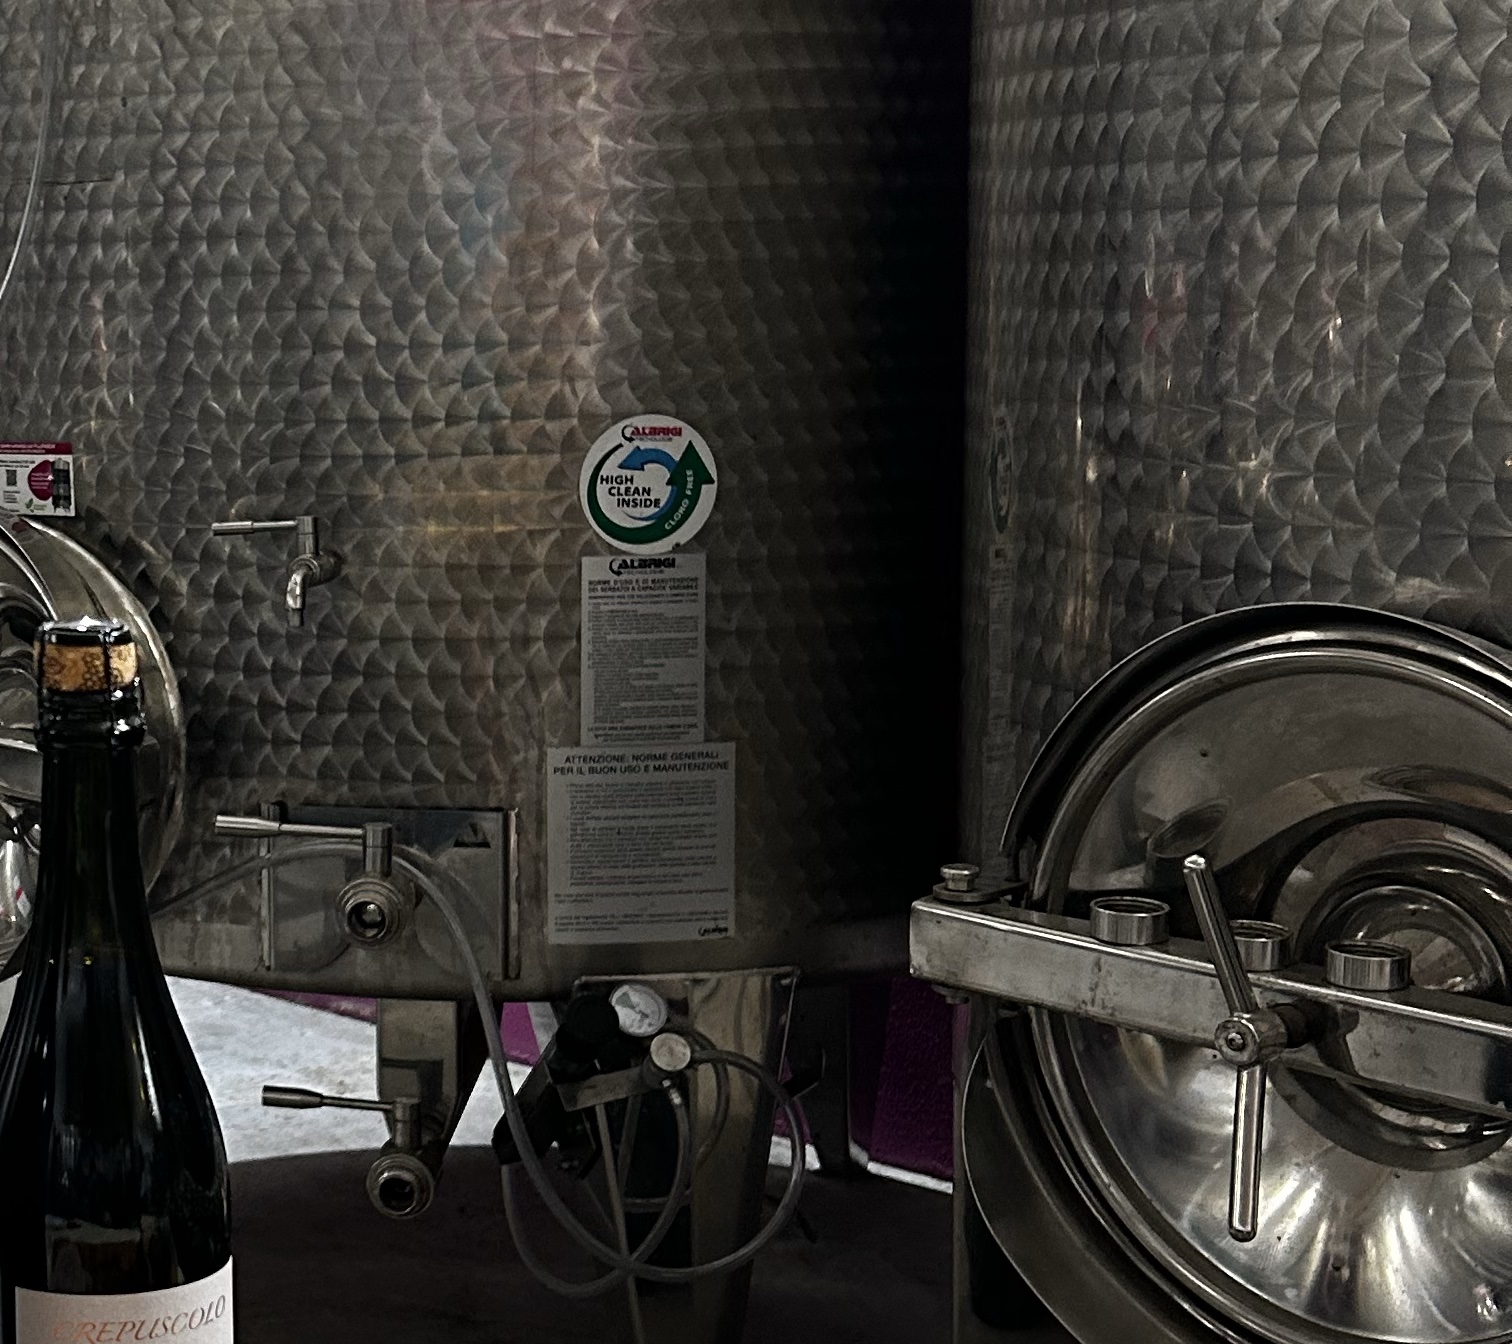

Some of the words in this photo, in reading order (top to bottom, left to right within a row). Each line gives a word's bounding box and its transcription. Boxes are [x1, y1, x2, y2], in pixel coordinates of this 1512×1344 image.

[630, 426, 683, 437] ALBRIGI
[600, 474, 634, 485] HIGH
[608, 486, 651, 497] CLEAN
[617, 497, 661, 508] INSIDE
[664, 498, 690, 530] CLORO
[685, 469, 694, 496] FREE
[618, 557, 676, 569] ALBRIGI
[632, 753, 666, 763] NORME
[670, 751, 719, 761] GENERALI
[553, 766, 574, 776] PER
[576, 766, 586, 776] IL
[588, 765, 617, 775] BUON
[620, 765, 641, 774] USO
[653, 761, 730, 773] MANUTENZIONE
